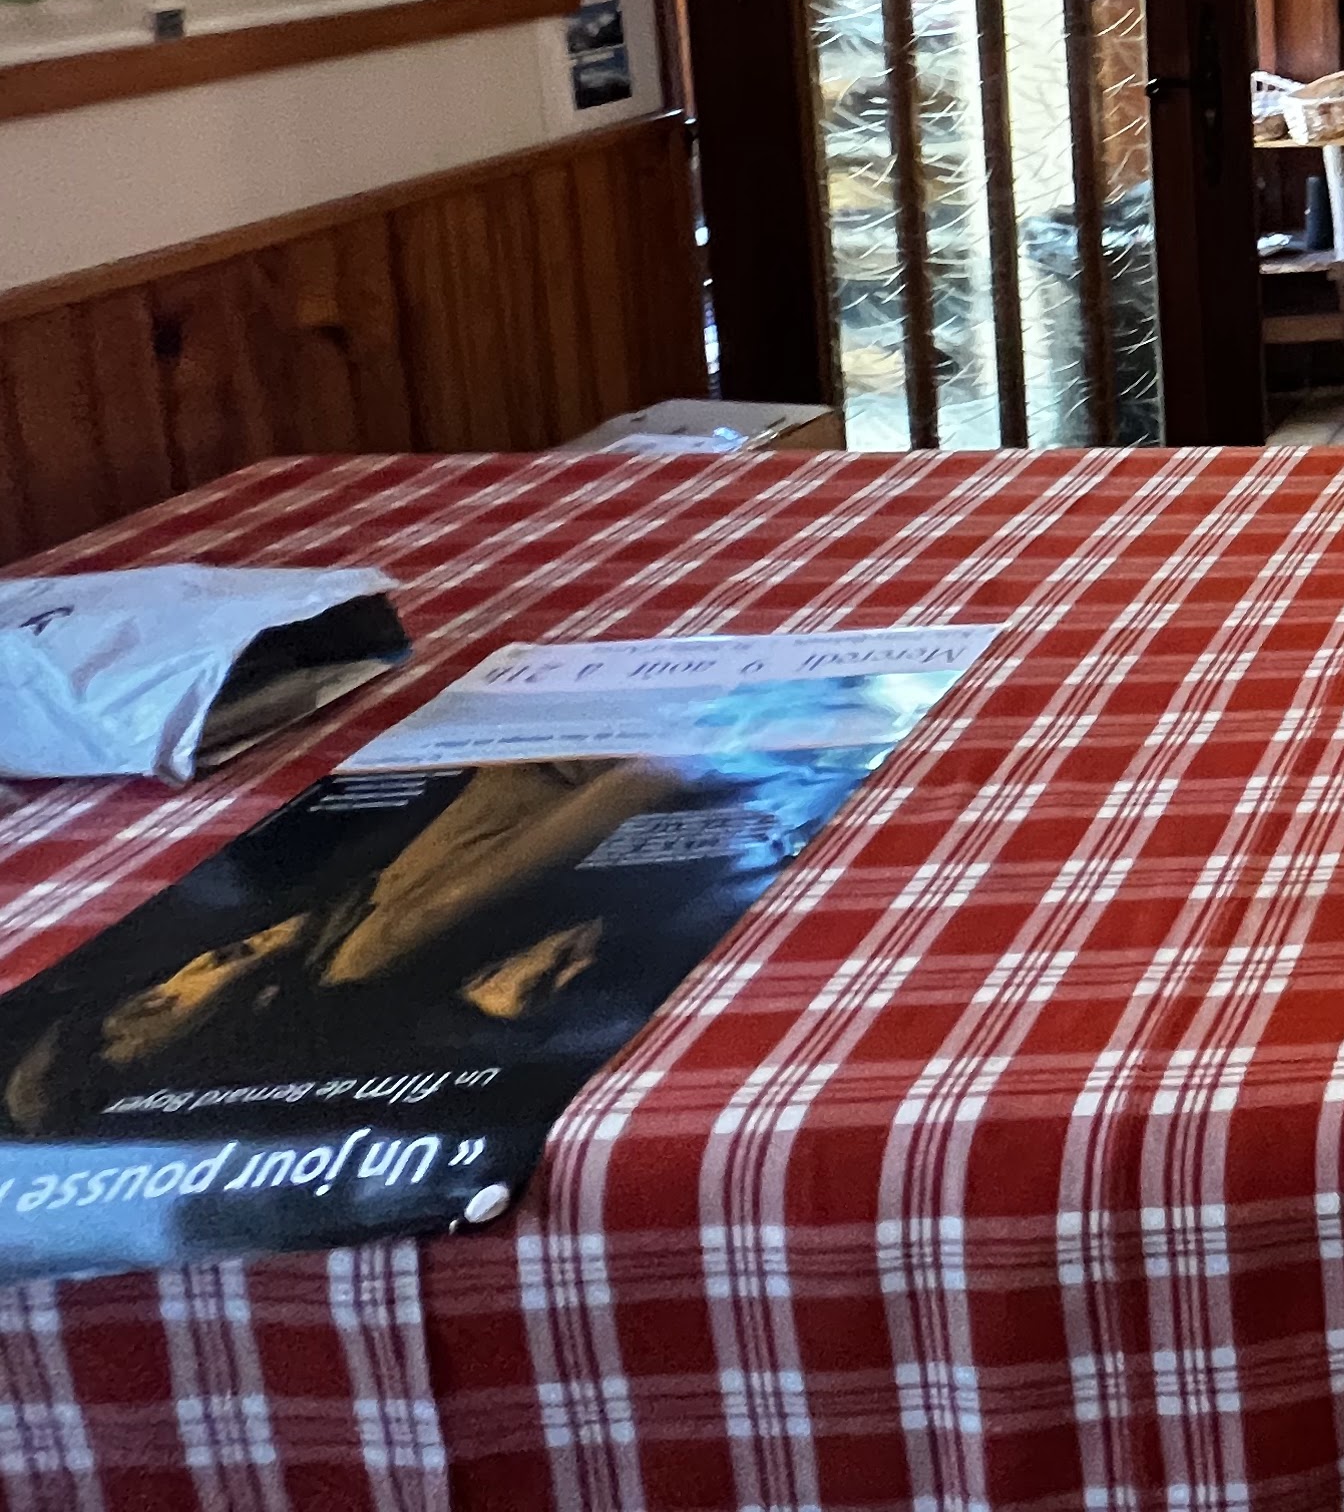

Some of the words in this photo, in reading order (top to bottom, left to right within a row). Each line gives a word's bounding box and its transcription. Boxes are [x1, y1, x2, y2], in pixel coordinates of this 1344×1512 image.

[794, 645, 968, 674] Mercredi
[314, 1077, 359, 1101] de
[353, 1069, 454, 1105] film
[456, 1067, 503, 1090] Un
[100, 1089, 197, 1116] Boyer
[192, 1080, 317, 1112] Bernard
[222, 1126, 372, 1198] jour
[354, 1133, 443, 1186] Un
[14, 1140, 238, 1215] pousse
